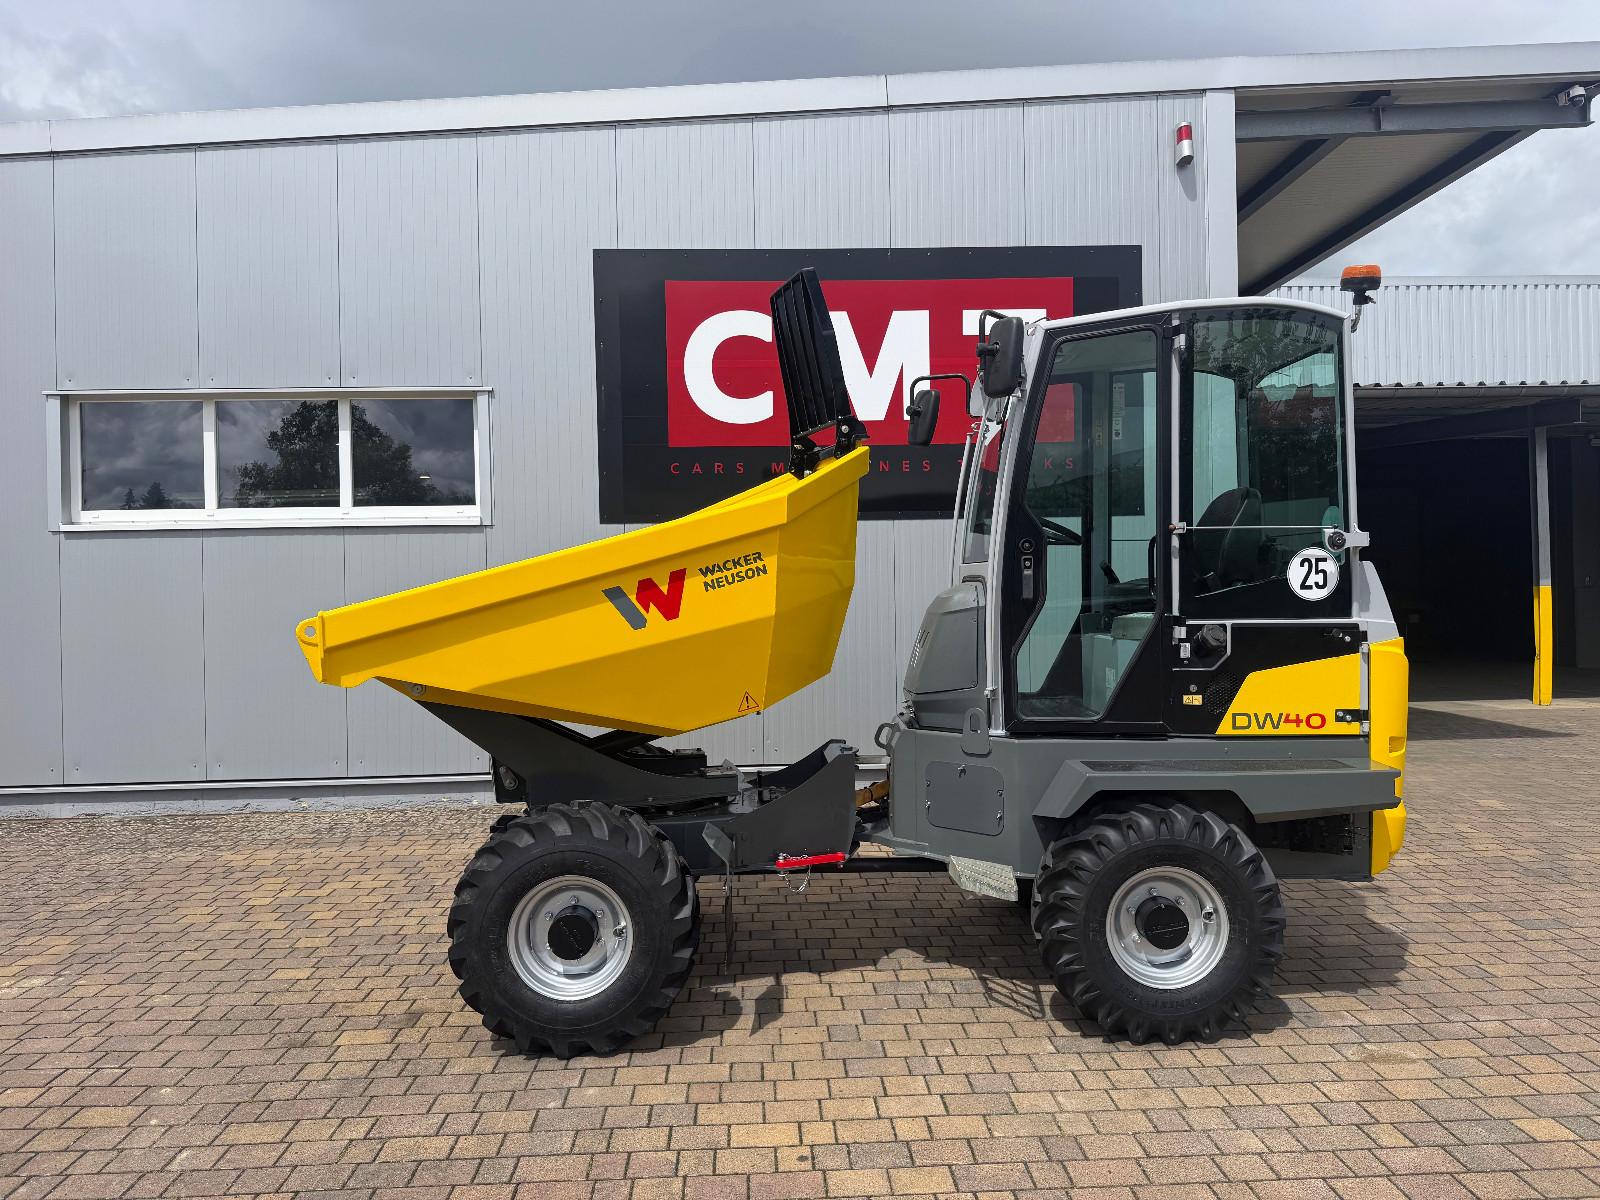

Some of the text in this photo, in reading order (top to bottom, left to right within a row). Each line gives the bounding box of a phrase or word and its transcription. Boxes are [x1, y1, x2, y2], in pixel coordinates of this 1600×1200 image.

[670, 460, 931, 475] CARS MNES
[698, 551, 764, 578] WACKER
[703, 563, 768, 593] NEUSON
[1299, 557, 1328, 591] 25
[1231, 712, 1327, 731] DW40
